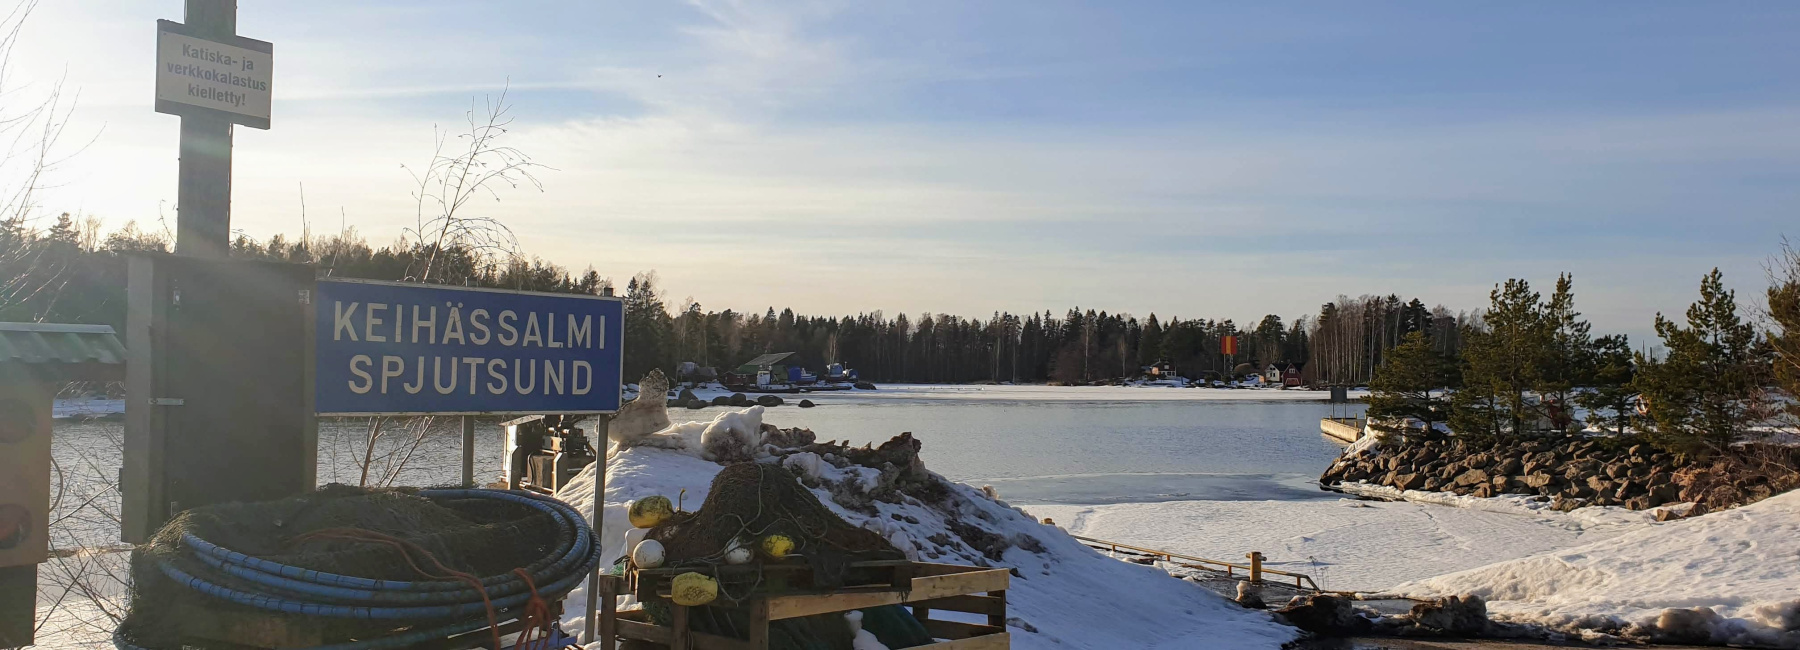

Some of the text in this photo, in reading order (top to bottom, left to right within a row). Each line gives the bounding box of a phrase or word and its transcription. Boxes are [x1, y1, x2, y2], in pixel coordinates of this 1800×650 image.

[181, 43, 254, 71] Katiska- ja
[167, 62, 266, 91] verkkokalastus
[187, 83, 246, 107] kielletty!
[333, 301, 605, 350] KEIHÄSSALMI
[348, 355, 593, 395] SPJUTSUND
